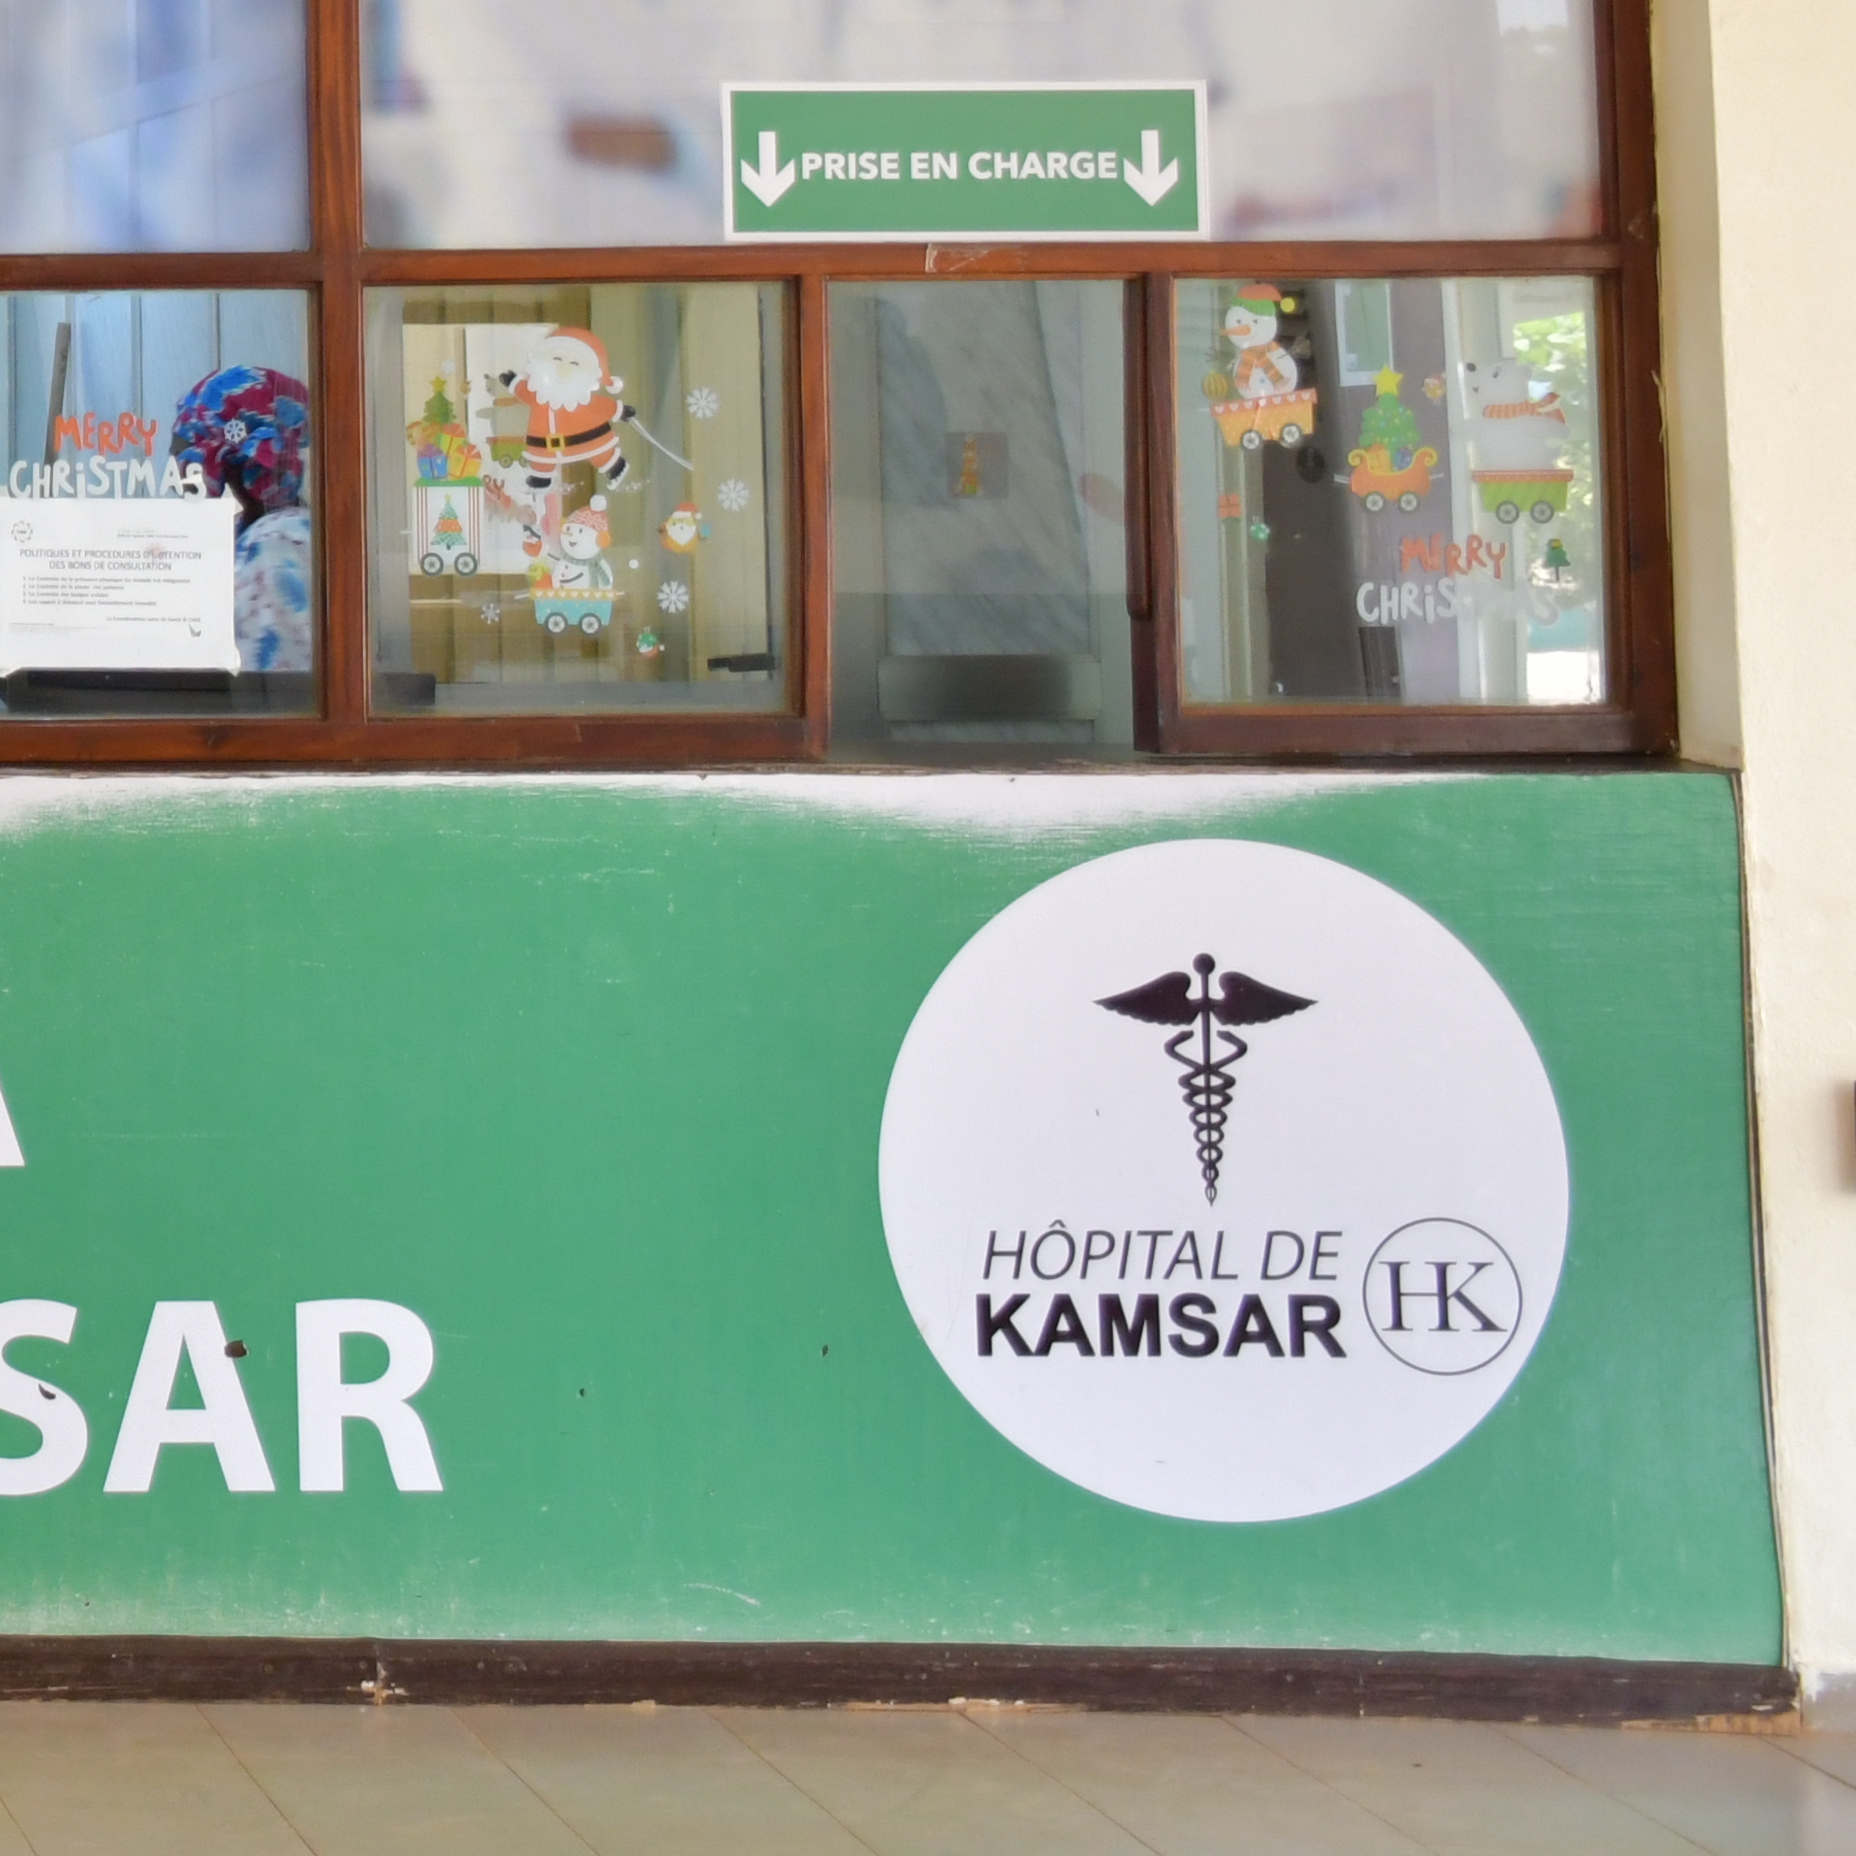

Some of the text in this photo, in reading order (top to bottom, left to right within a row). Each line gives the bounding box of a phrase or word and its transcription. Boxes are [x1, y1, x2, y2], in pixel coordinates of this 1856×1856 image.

[801, 150, 1118, 180] PRISE EN CHARGE
[54, 412, 157, 456] MERRY
[19, 548, 70, 559] POLITIQUES
[72, 548, 84, 559] ET
[49, 560, 66, 570] DES
[94, 561, 105, 571] DE
[1399, 533, 1506, 579] MERRY
[981, 1219, 1344, 1282] HÔPITAL DE
[1377, 1260, 1510, 1334] HK
[974, 1292, 1348, 1358] KAMSAR
